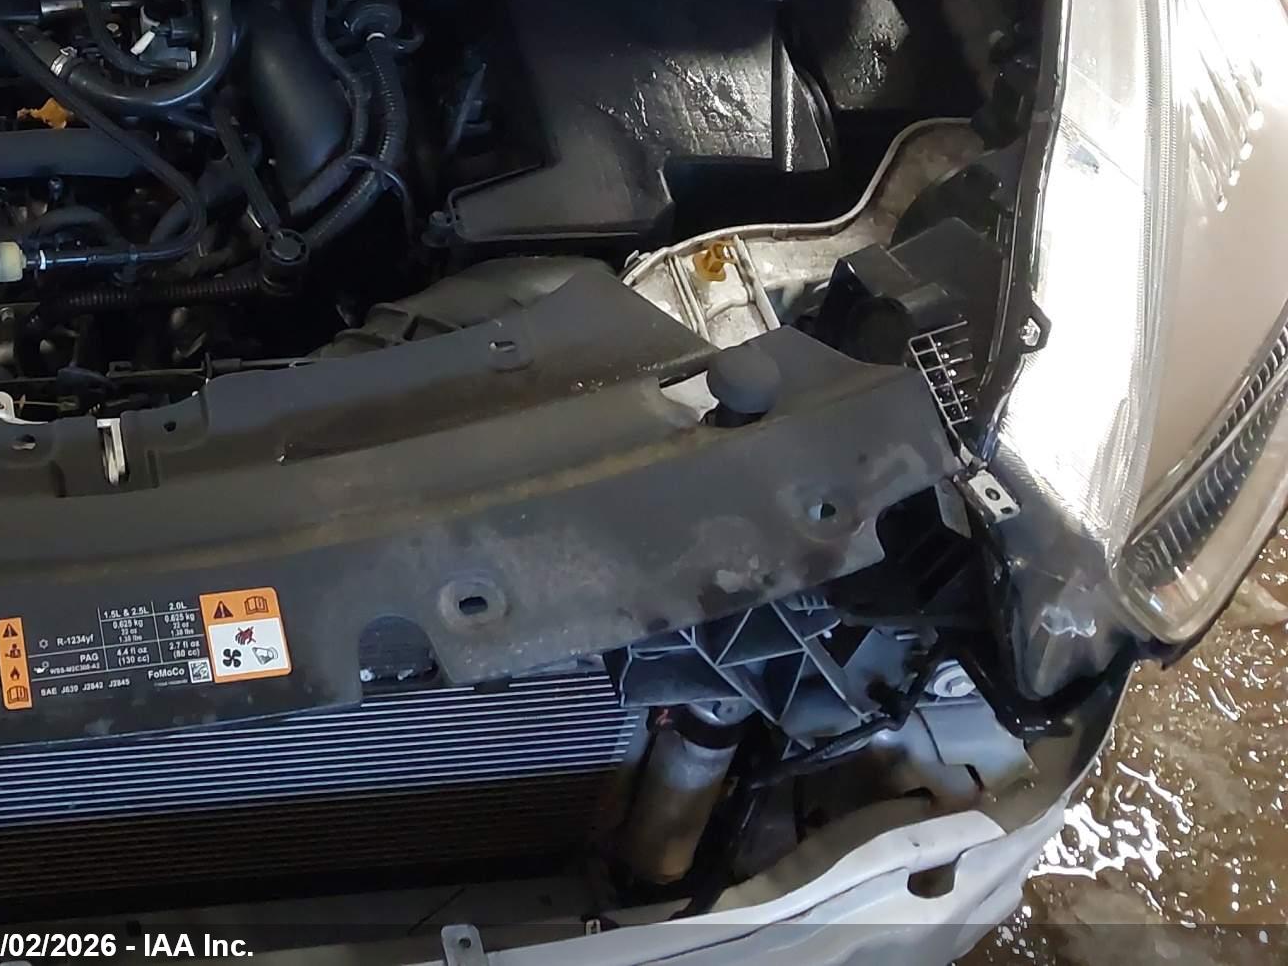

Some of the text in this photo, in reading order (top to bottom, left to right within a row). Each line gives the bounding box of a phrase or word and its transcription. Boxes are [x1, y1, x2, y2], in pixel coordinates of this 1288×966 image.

[168, 602, 188, 611] 2.0L
[103, 607, 149, 619] 1.5L & 2.5L
[164, 612, 195, 624] 0.625 kg
[112, 619, 144, 629] 0.625 kg
[56, 633, 94, 647] R-1234yf
[137, 646, 148, 654] oz
[169, 642, 181, 651] 2.7
[79, 653, 99, 664] PAG
[118, 654, 150, 667] (130 cc)
[147, 667, 185, 680] FoMoCo
[40, 687, 57, 697] SAE
